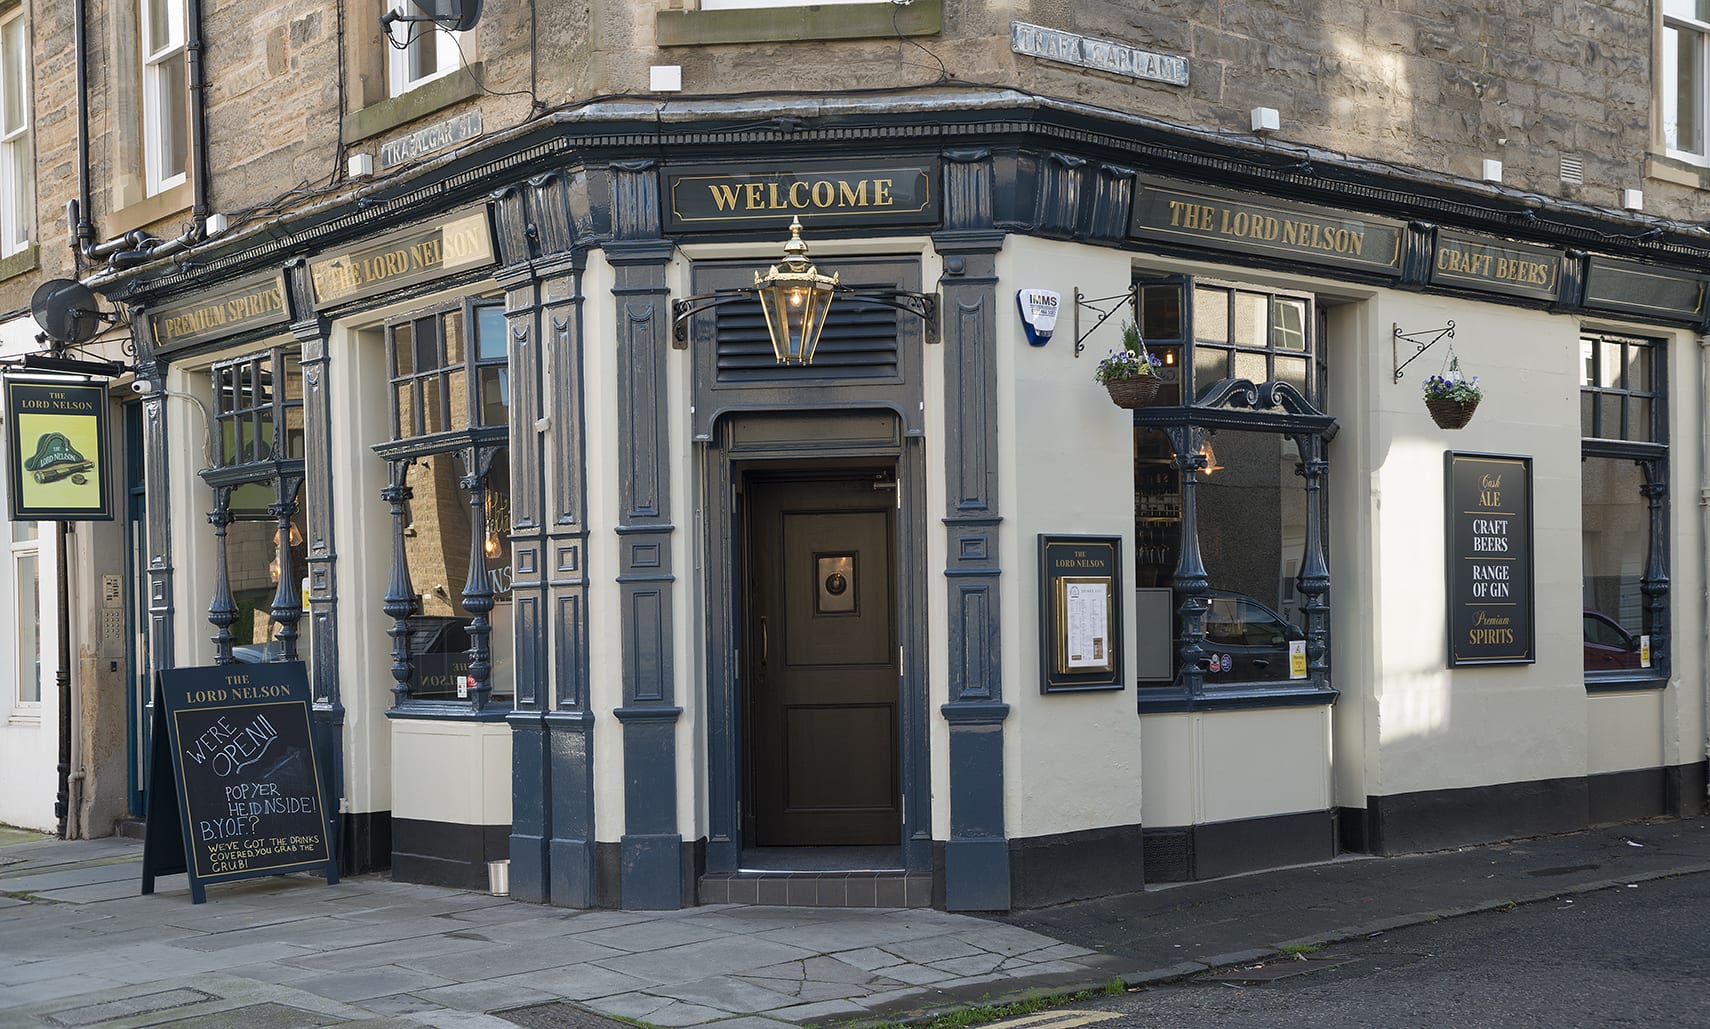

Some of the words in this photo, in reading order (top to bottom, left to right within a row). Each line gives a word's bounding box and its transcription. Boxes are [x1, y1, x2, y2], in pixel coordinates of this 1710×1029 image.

[1019, 27, 1130, 68] TRAFAGAR
[708, 178, 894, 212] WELCOME
[1169, 200, 1215, 231] THE
[1220, 208, 1280, 241] LORD
[1281, 219, 1366, 256] NELSON
[330, 261, 361, 290] THE
[363, 248, 410, 283] LORD
[411, 227, 480, 270] NELSON
[1437, 248, 1493, 276] CRAFT
[1495, 257, 1548, 285] BEERS
[1029, 294, 1058, 307] IMMS
[164, 303, 227, 338] PREMIUM
[228, 287, 283, 321] SPIRITS
[49, 392, 66, 400] THE
[22, 399, 50, 409] LORD
[52, 400, 93, 410] NELSON
[40, 455, 54, 467] LORD
[54, 452, 76, 462] NELSON
[1480, 473, 1502, 489] Cask
[1479, 490, 1501, 507] ALE
[1473, 519, 1508, 535] CRAFT
[1474, 536, 1508, 552] BEERS
[1055, 559, 1075, 568] LORD
[1076, 559, 1105, 568] NELSON
[1473, 565, 1510, 580] RANGE
[1473, 582, 1488, 598] OF
[1490, 582, 1510, 598] GIN
[1474, 611, 1510, 626] Premium
[1469, 628, 1514, 645] SPIRITS
[225, 674, 250, 685] THE
[186, 689, 227, 704] LORD
[231, 684, 291, 700] NELSON
[225, 783, 249, 802] POP
[251, 782, 281, 799] YER
[228, 802, 262, 816] HEID
[243, 839, 265, 849] GOT
[268, 837, 288, 847] THE
[290, 835, 320, 844] DRINKS
